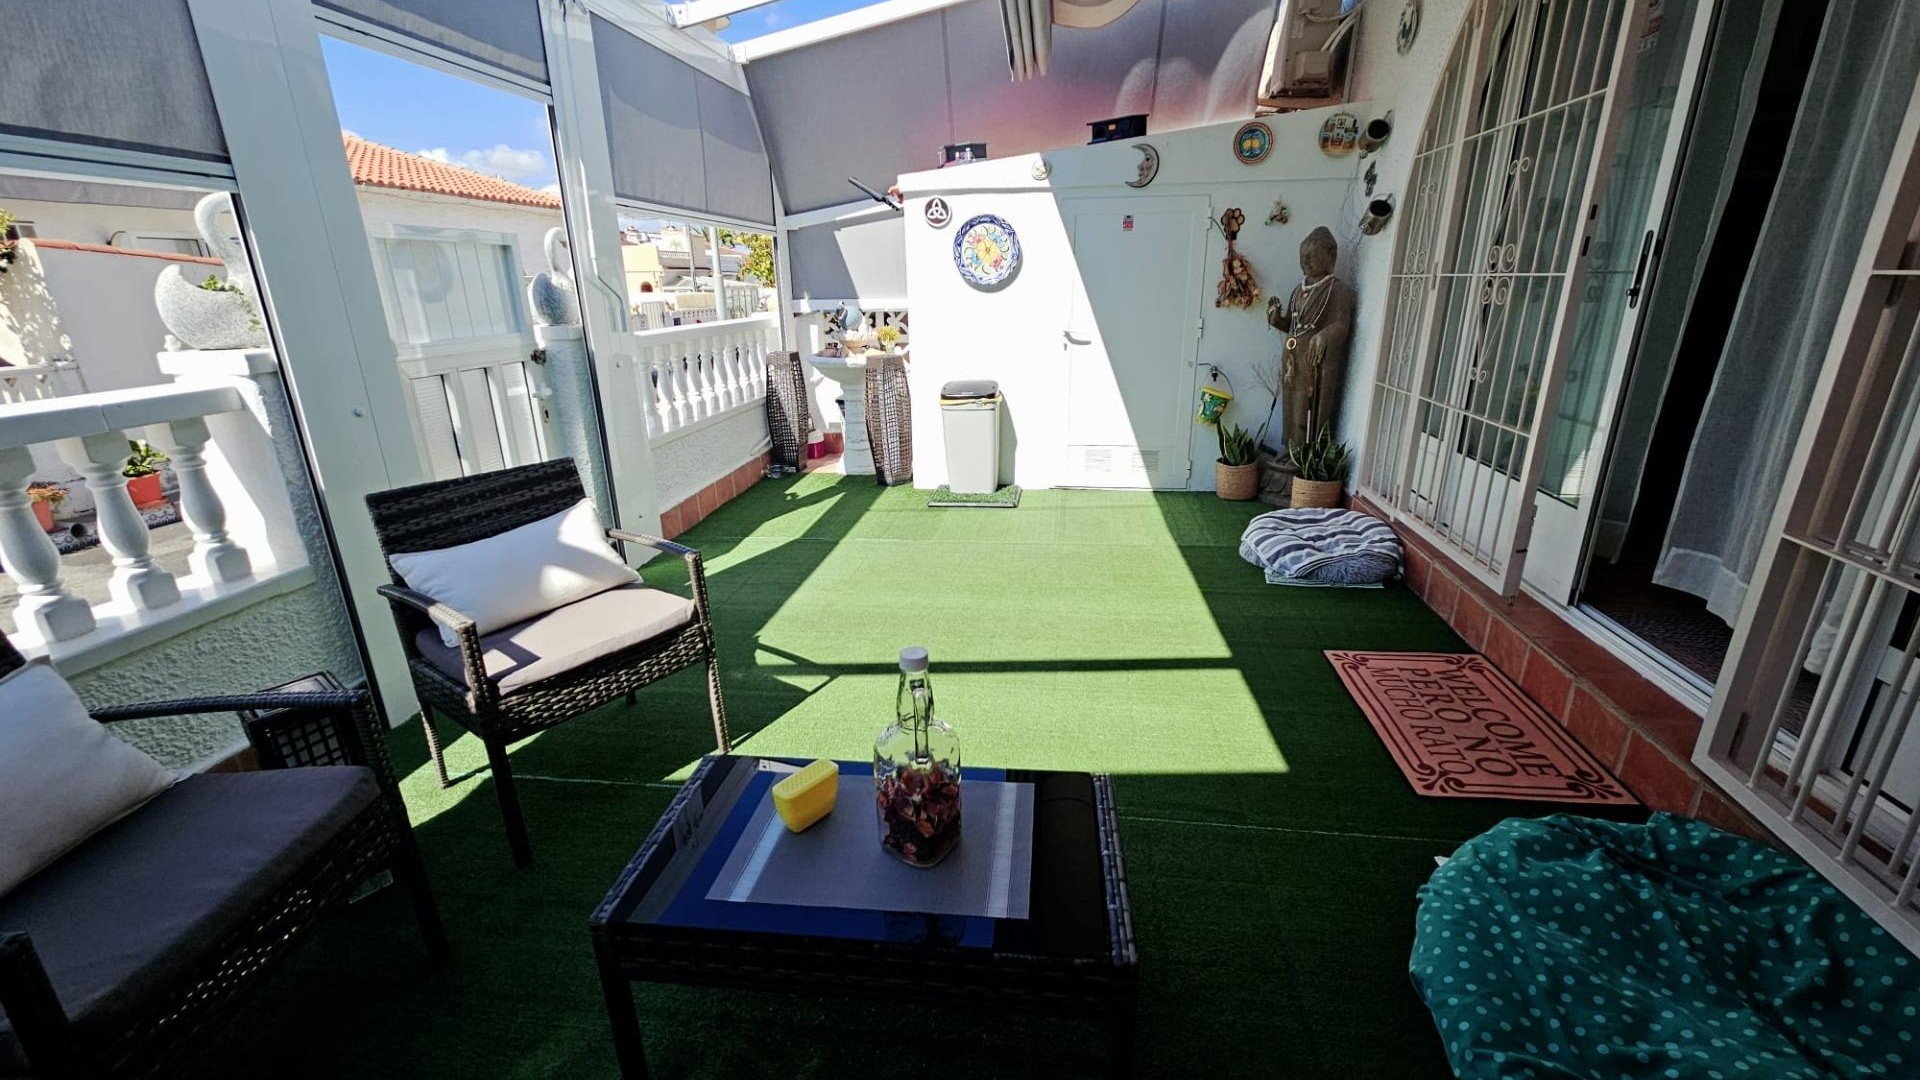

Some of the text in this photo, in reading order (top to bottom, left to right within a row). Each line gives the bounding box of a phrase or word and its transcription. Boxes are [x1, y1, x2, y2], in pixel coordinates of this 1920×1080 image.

[1366, 666, 1476, 775] MUCHO RATO
[1398, 667, 1517, 776] PERO NO
[1434, 668, 1564, 777] WELCOME
